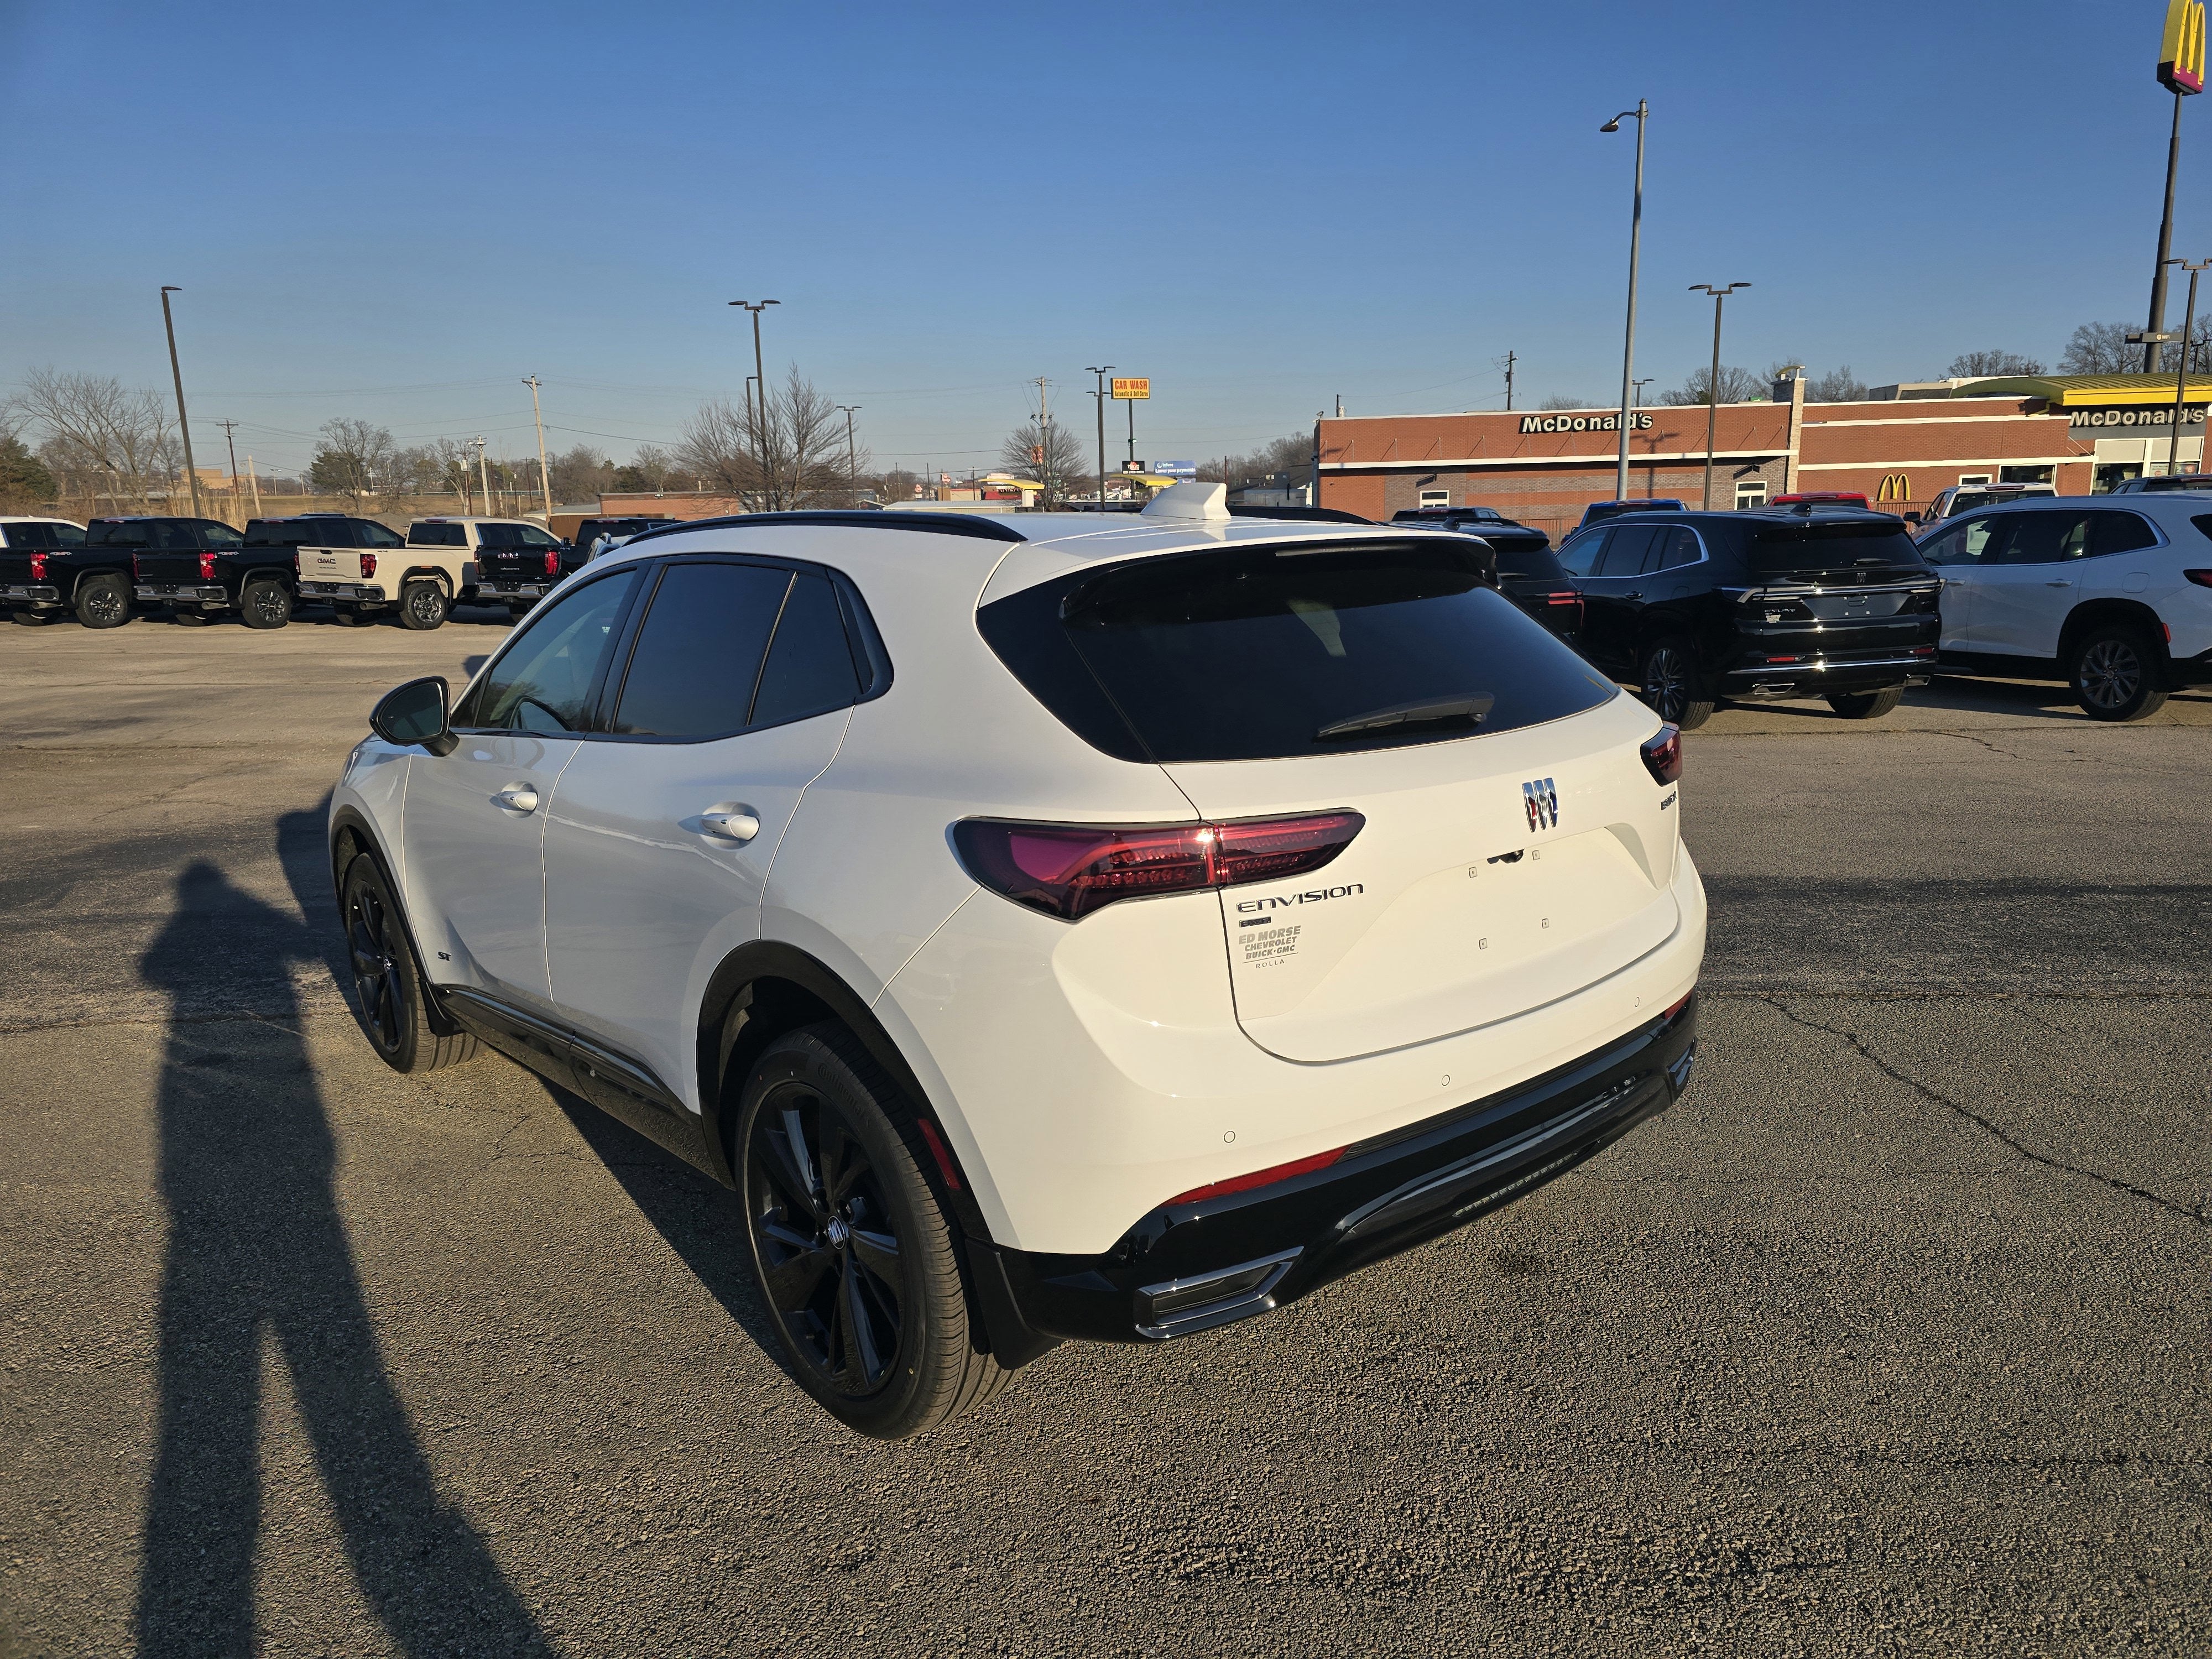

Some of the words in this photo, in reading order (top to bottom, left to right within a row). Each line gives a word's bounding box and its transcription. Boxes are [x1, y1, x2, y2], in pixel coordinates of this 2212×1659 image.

[1115, 380, 1128, 389] CAR
[1130, 380, 1147, 389] WASH
[1236, 884, 1364, 913] ENVISION
[1238, 933, 1256, 945] ED
[1258, 925, 1301, 942] MORSE
[1244, 936, 1297, 952] CHEVROLET
[1256, 959, 1285, 969] ROLLA
